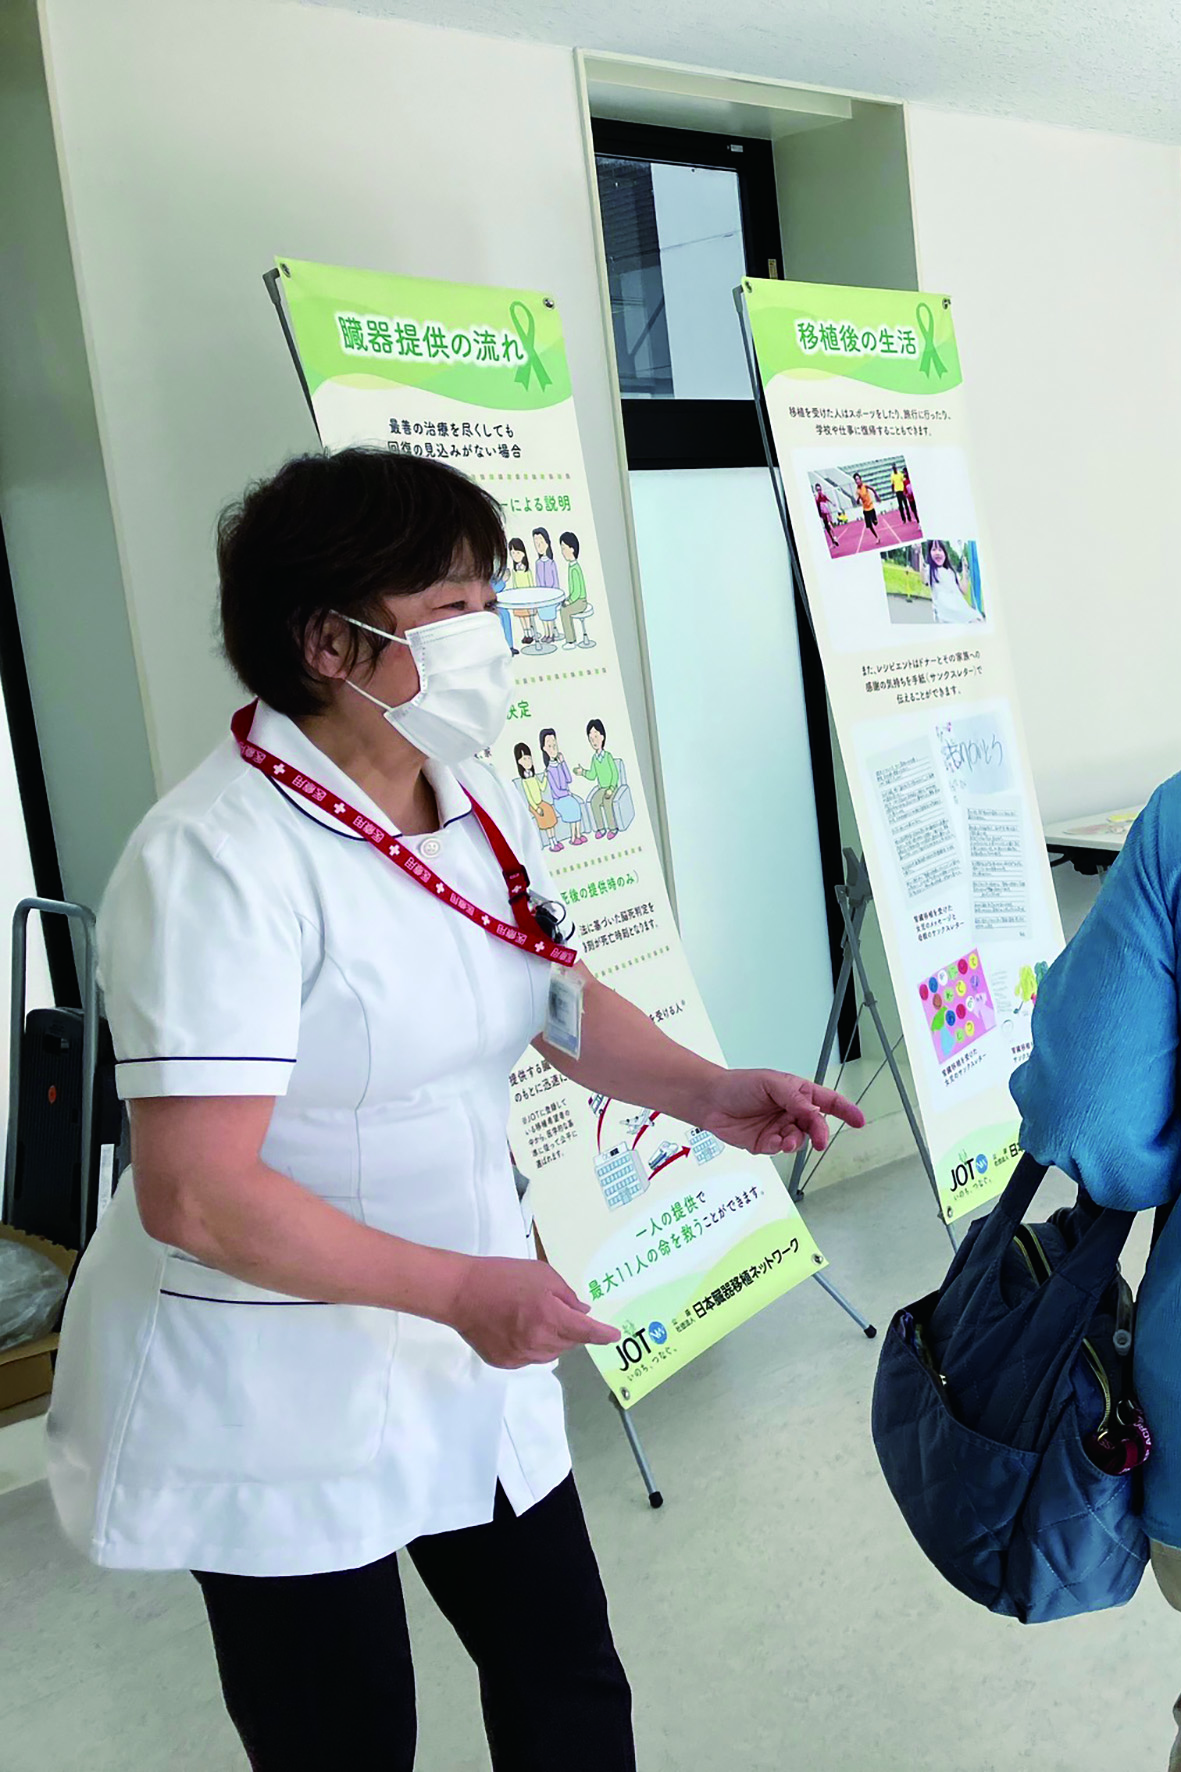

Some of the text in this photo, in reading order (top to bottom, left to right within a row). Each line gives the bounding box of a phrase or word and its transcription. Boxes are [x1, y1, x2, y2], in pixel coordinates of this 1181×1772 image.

[339, 316, 525, 363] 臓器提供の流れ
[797, 322, 917, 354] 移植後の生活
[388, 418, 514, 438] 最善の治療を尽くしても
[387, 441, 522, 459] 回復の見込みがない場合
[292, 773, 328, 802] 医療用
[353, 814, 385, 844] 医療用
[404, 856, 432, 884] 医療用
[449, 892, 476, 917] 医療用
[579, 902, 656, 937] 法に基づいた脳死判定を
[496, 923, 528, 946] 医療用
[950, 1158, 975, 1192] JOT
[635, 1190, 707, 1239] 一人の提供で
[588, 1185, 765, 1302] 最大11人の命を救うことができます。
[692, 1238, 800, 1319] 日本臓器移植ネットワーク
[615, 1327, 652, 1372] JOT
